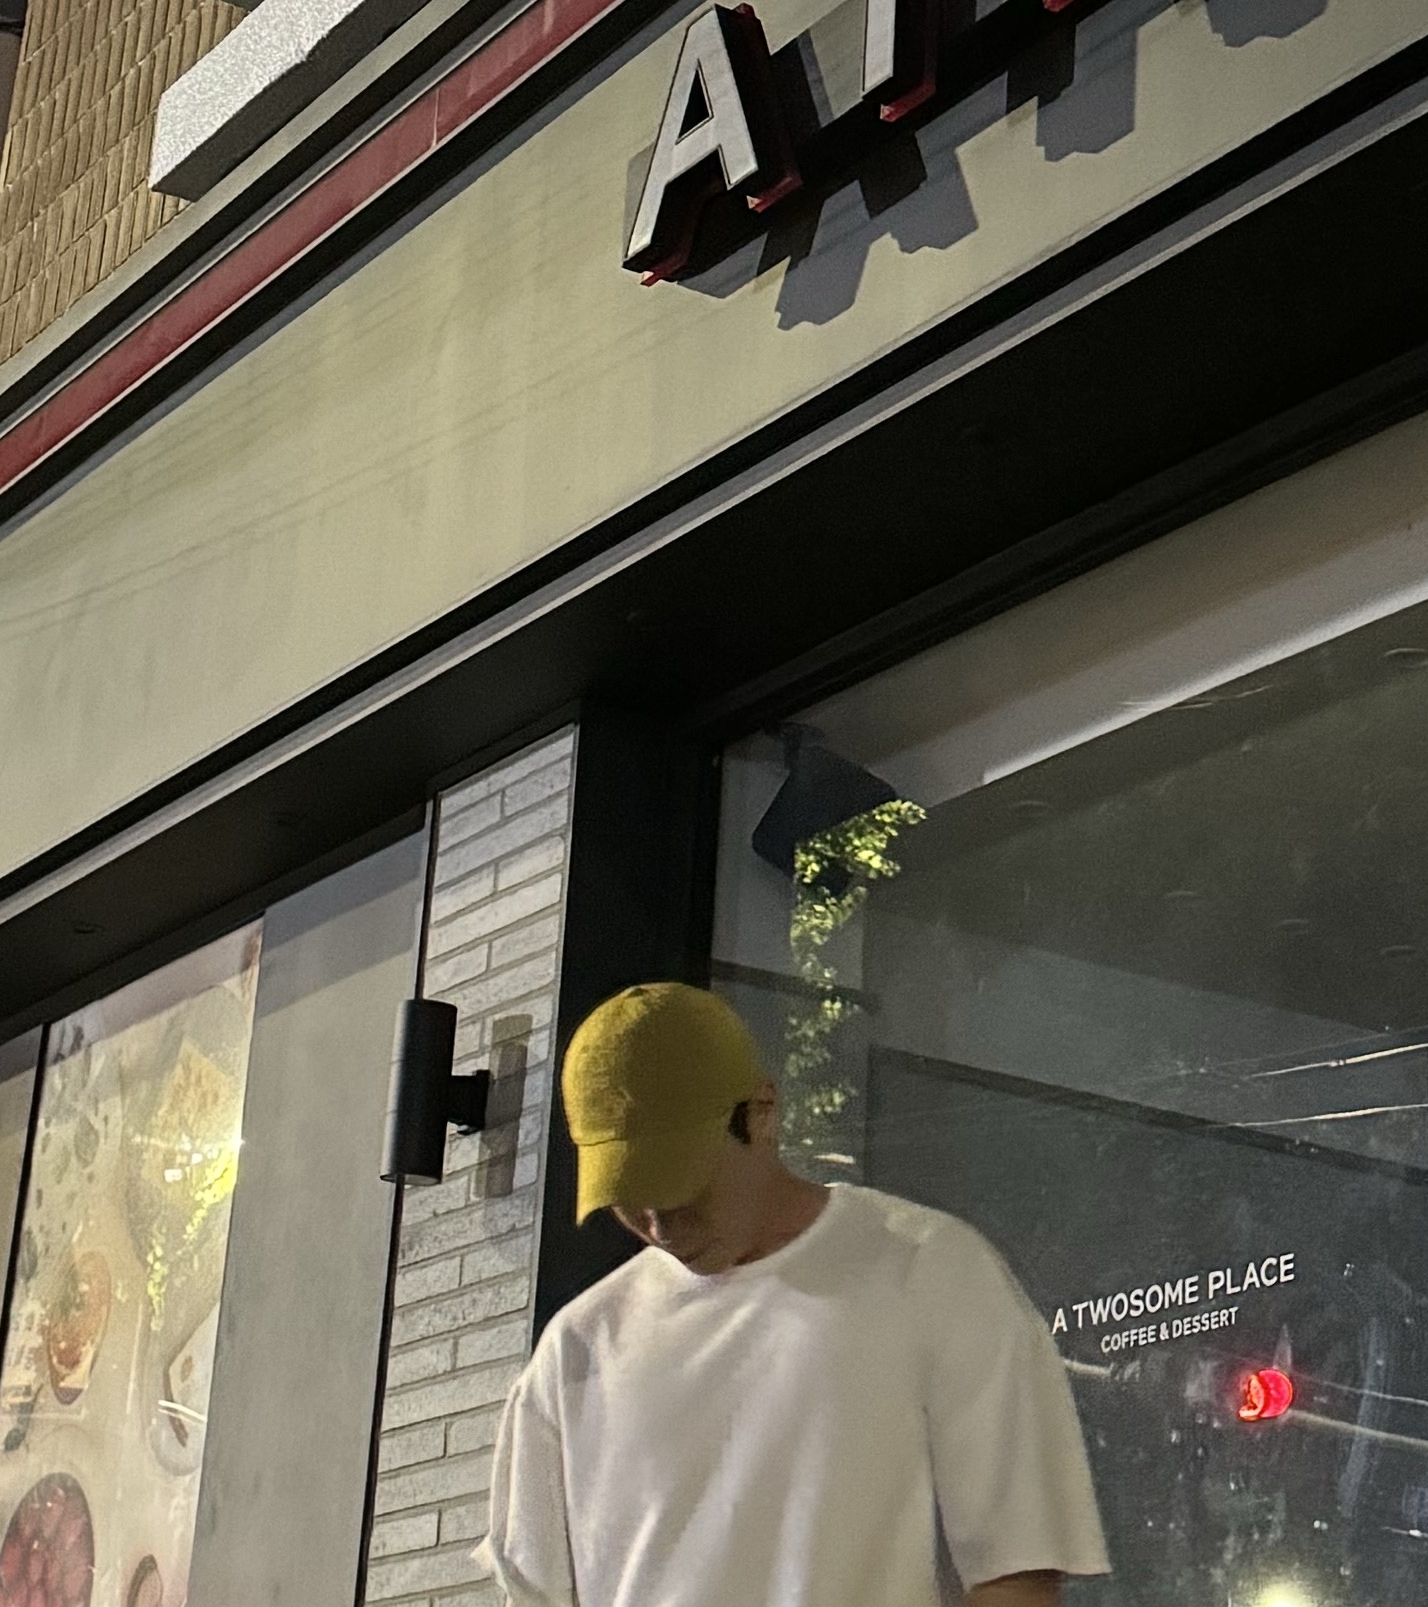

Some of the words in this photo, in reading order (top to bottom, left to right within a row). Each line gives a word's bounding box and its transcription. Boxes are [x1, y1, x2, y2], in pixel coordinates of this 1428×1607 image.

[625, 3, 759, 261] A
[1052, 1308, 1068, 1334] A
[1073, 1275, 1200, 1329] TWOSOME
[1208, 1253, 1295, 1300] PLACE
[1100, 1328, 1157, 1354] COFFEE
[1159, 1322, 1170, 1341] &
[1171, 1306, 1239, 1340] DESSERT
